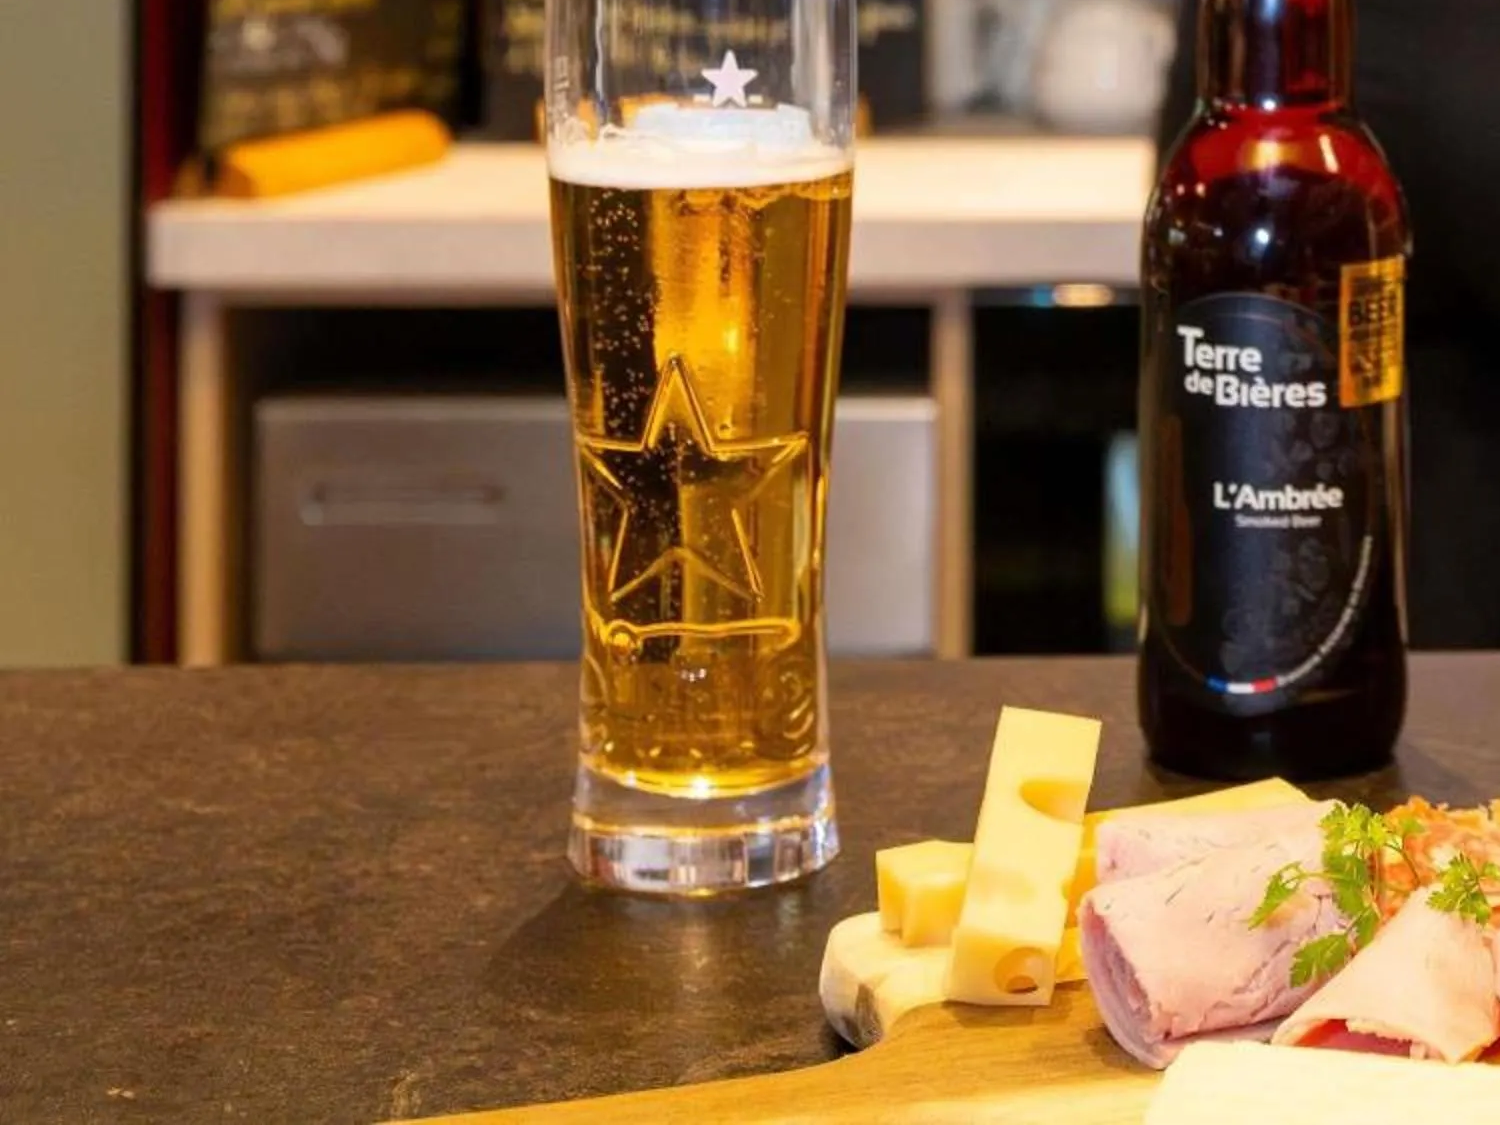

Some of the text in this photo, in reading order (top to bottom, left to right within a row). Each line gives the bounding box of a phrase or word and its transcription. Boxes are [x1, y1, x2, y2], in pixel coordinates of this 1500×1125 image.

[1176, 325, 1262, 372] Terre
[1184, 370, 1327, 408] de Bières
[1213, 481, 1343, 510] L'Ambrée
